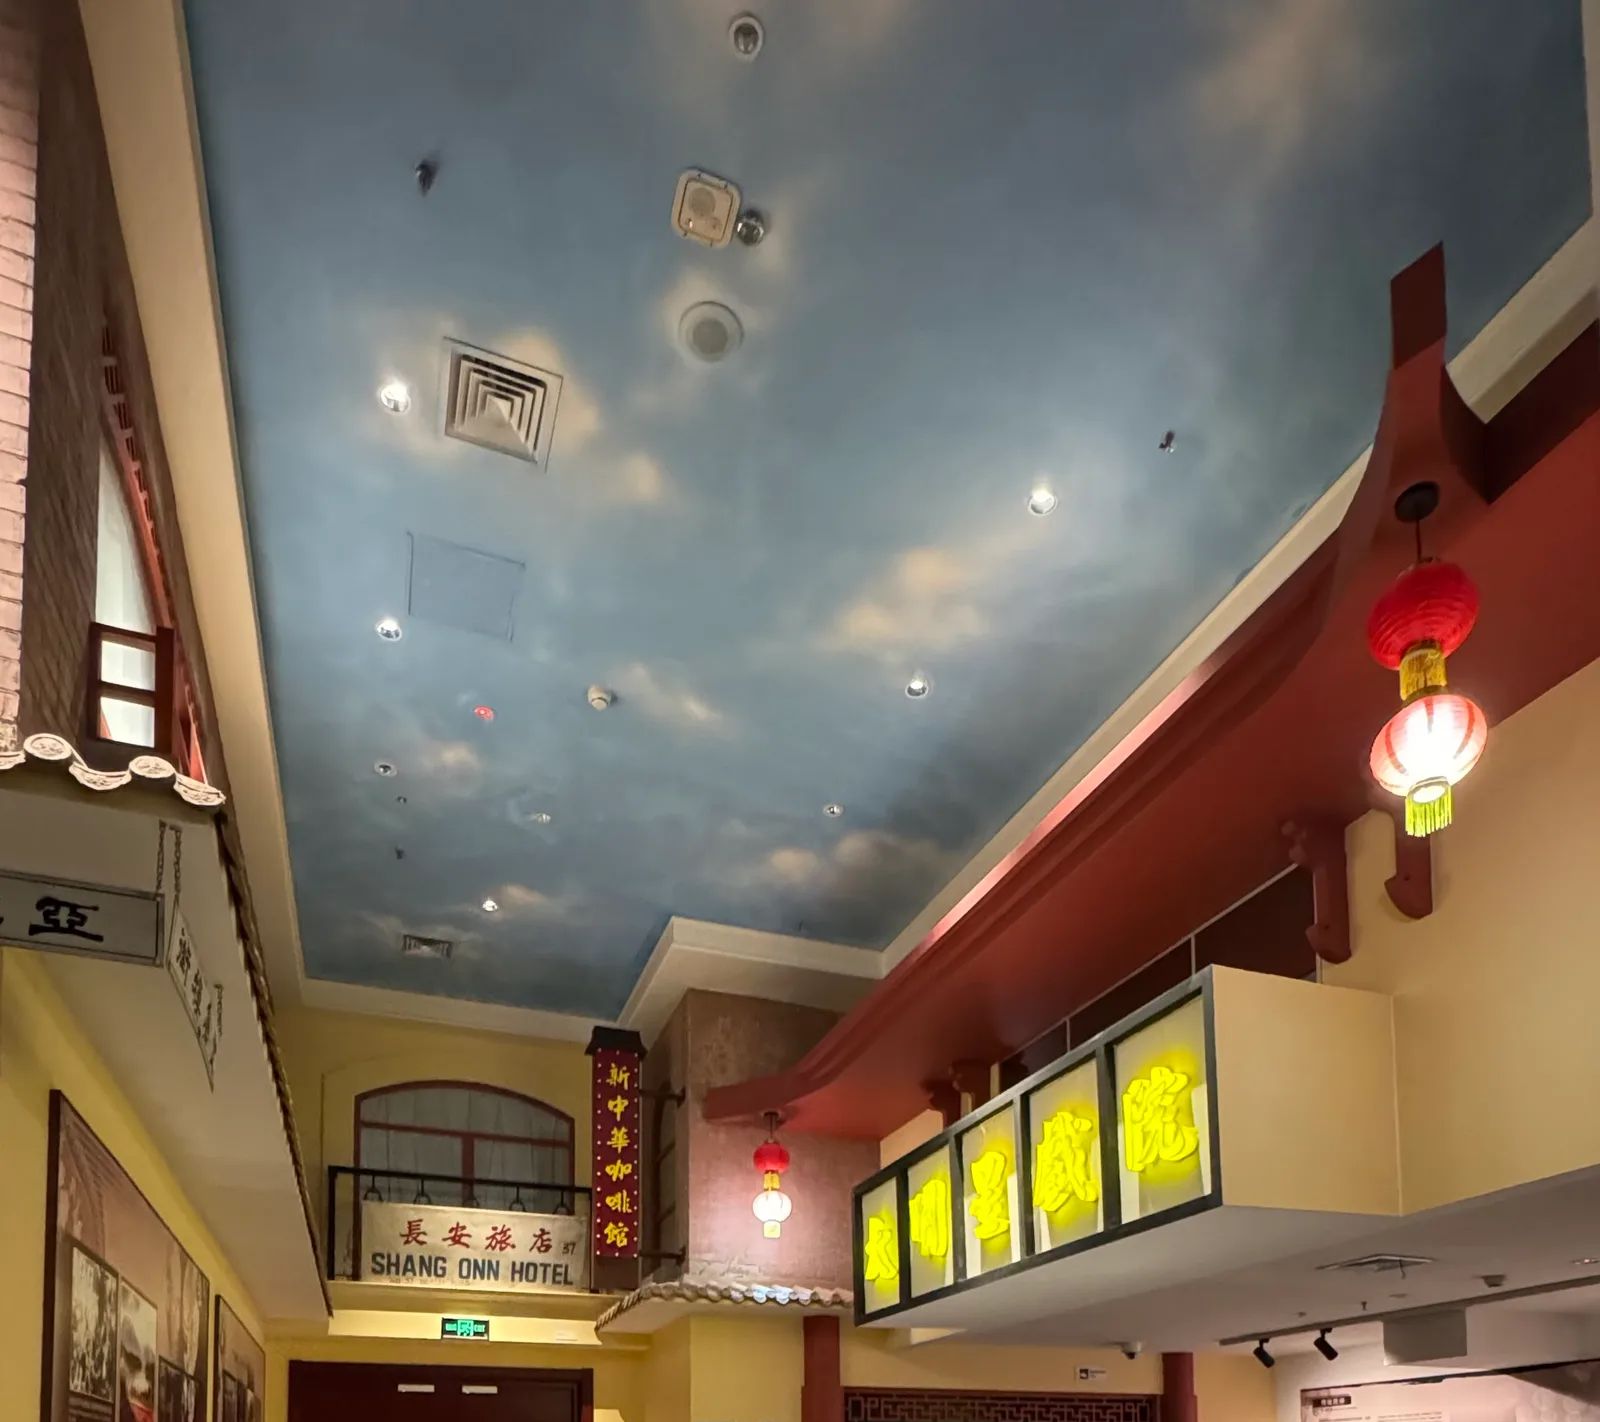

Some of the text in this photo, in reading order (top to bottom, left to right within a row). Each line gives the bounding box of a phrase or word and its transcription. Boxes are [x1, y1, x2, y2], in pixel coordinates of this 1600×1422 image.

[0, 896, 104, 942] 亞
[603, 1063, 632, 1247] 新中華咖啡館
[399, 1218, 553, 1254] 長安旅店
[562, 1242, 577, 1256] 37
[371, 1252, 574, 1286] SHANG ONN HOTEL
